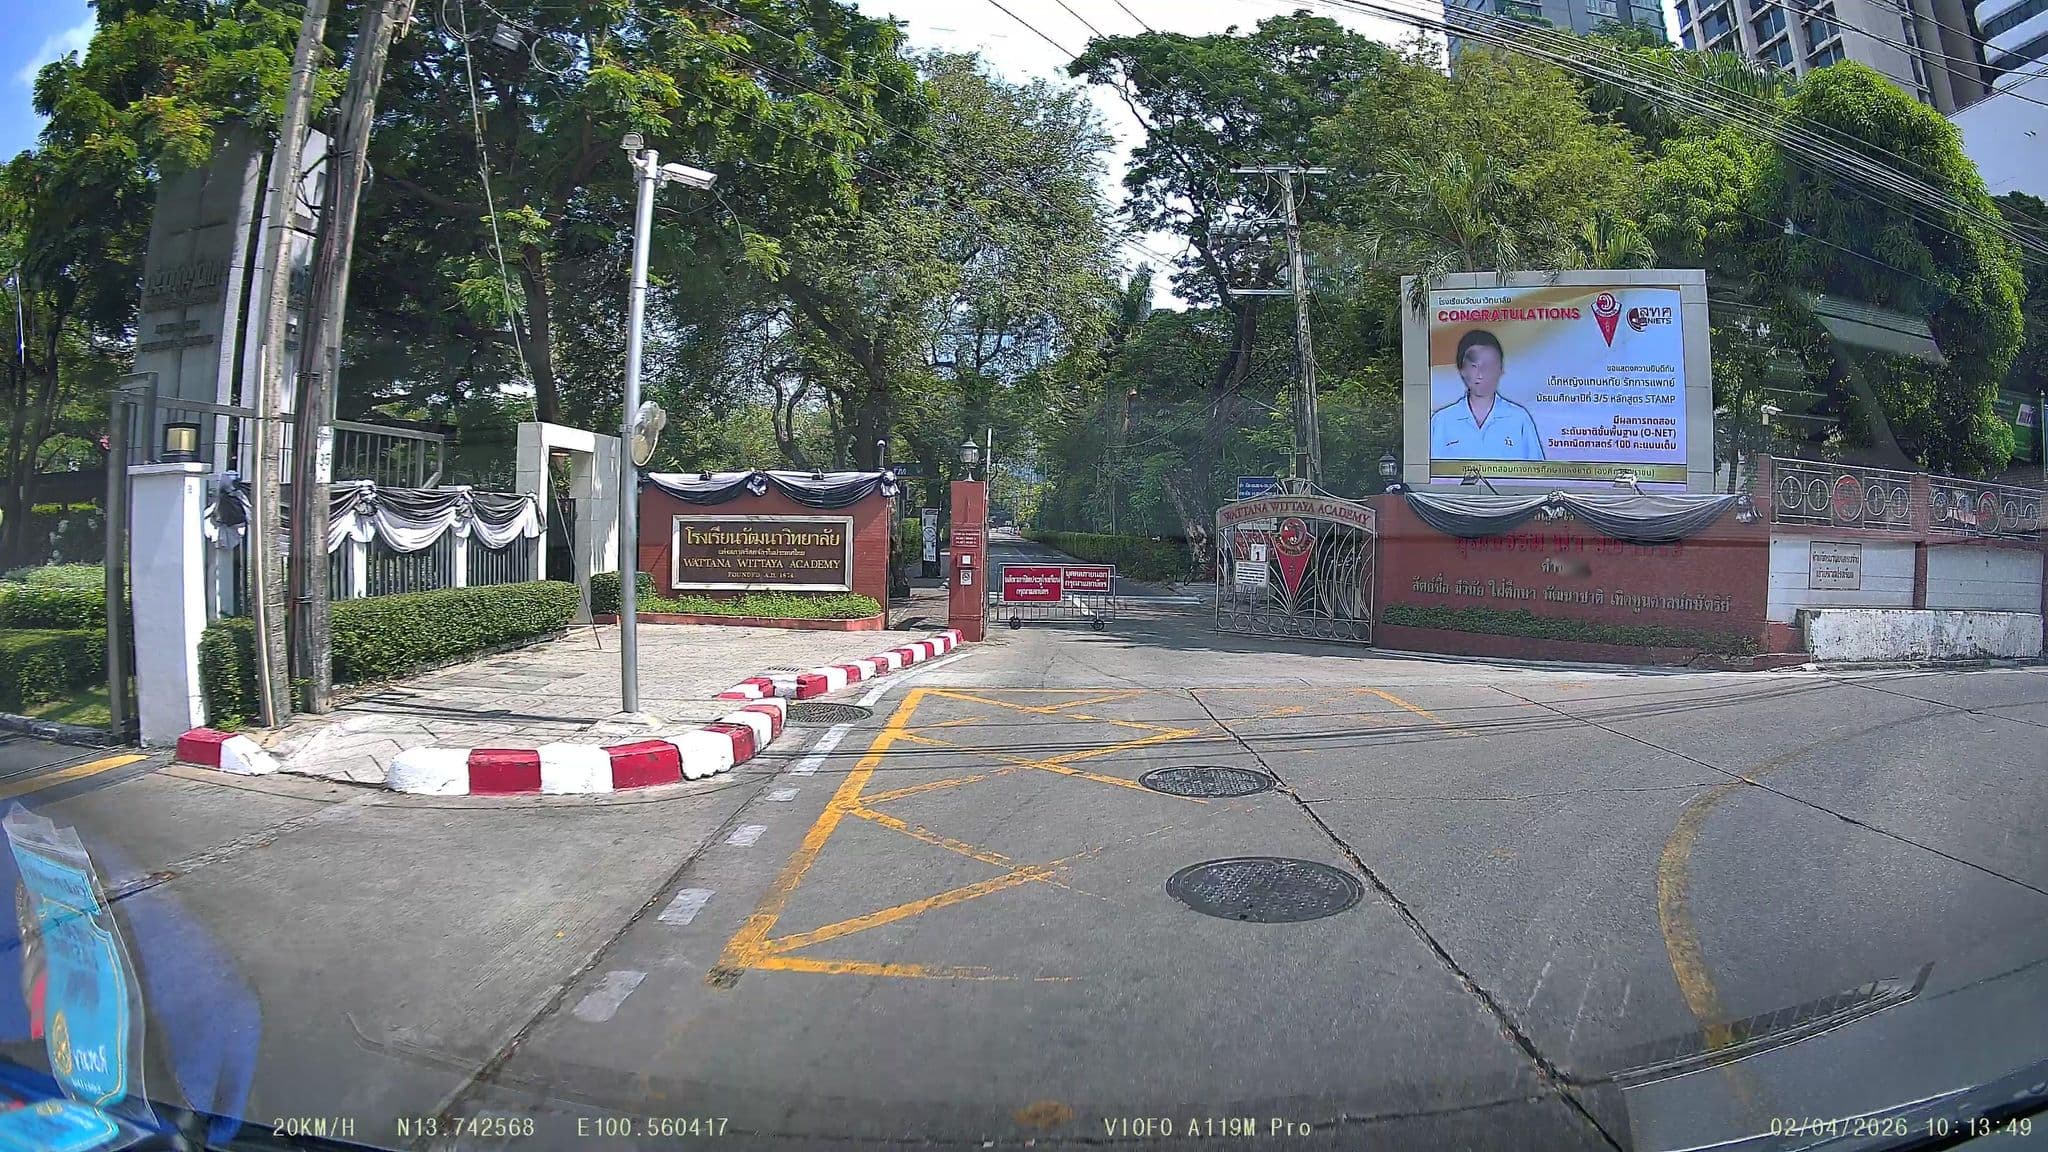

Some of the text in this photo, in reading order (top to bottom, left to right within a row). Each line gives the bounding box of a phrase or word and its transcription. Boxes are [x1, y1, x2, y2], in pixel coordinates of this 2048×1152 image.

[1438, 307, 1581, 322] CONGRATULATIONS
[1623, 377, 1676, 388] รักการแพทย์
[1536, 392, 1676, 405] มัธยมศึกษาปีที่ 3/5 หลักสูตร STAMP
[1613, 415, 1676, 426] มีผลการทดสอบ
[1561, 426, 1677, 438] ระดับชาติขั้นพื้นฐาน (O-NET)
[1548, 438, 1677, 450] วิชาคณิตศาสตร์ 100 คะแนนเต็ม
[1223, 501, 1370, 525] WATTANA WITTAYA ACADEMY
[684, 526, 840, 547] โรงเรียนวัฒนาวิทยาลัย
[683, 558, 841, 569] WATTANA WITTAYA ACADEMY
[1488, 578, 1537, 599] ใฝ่ศึกษา
